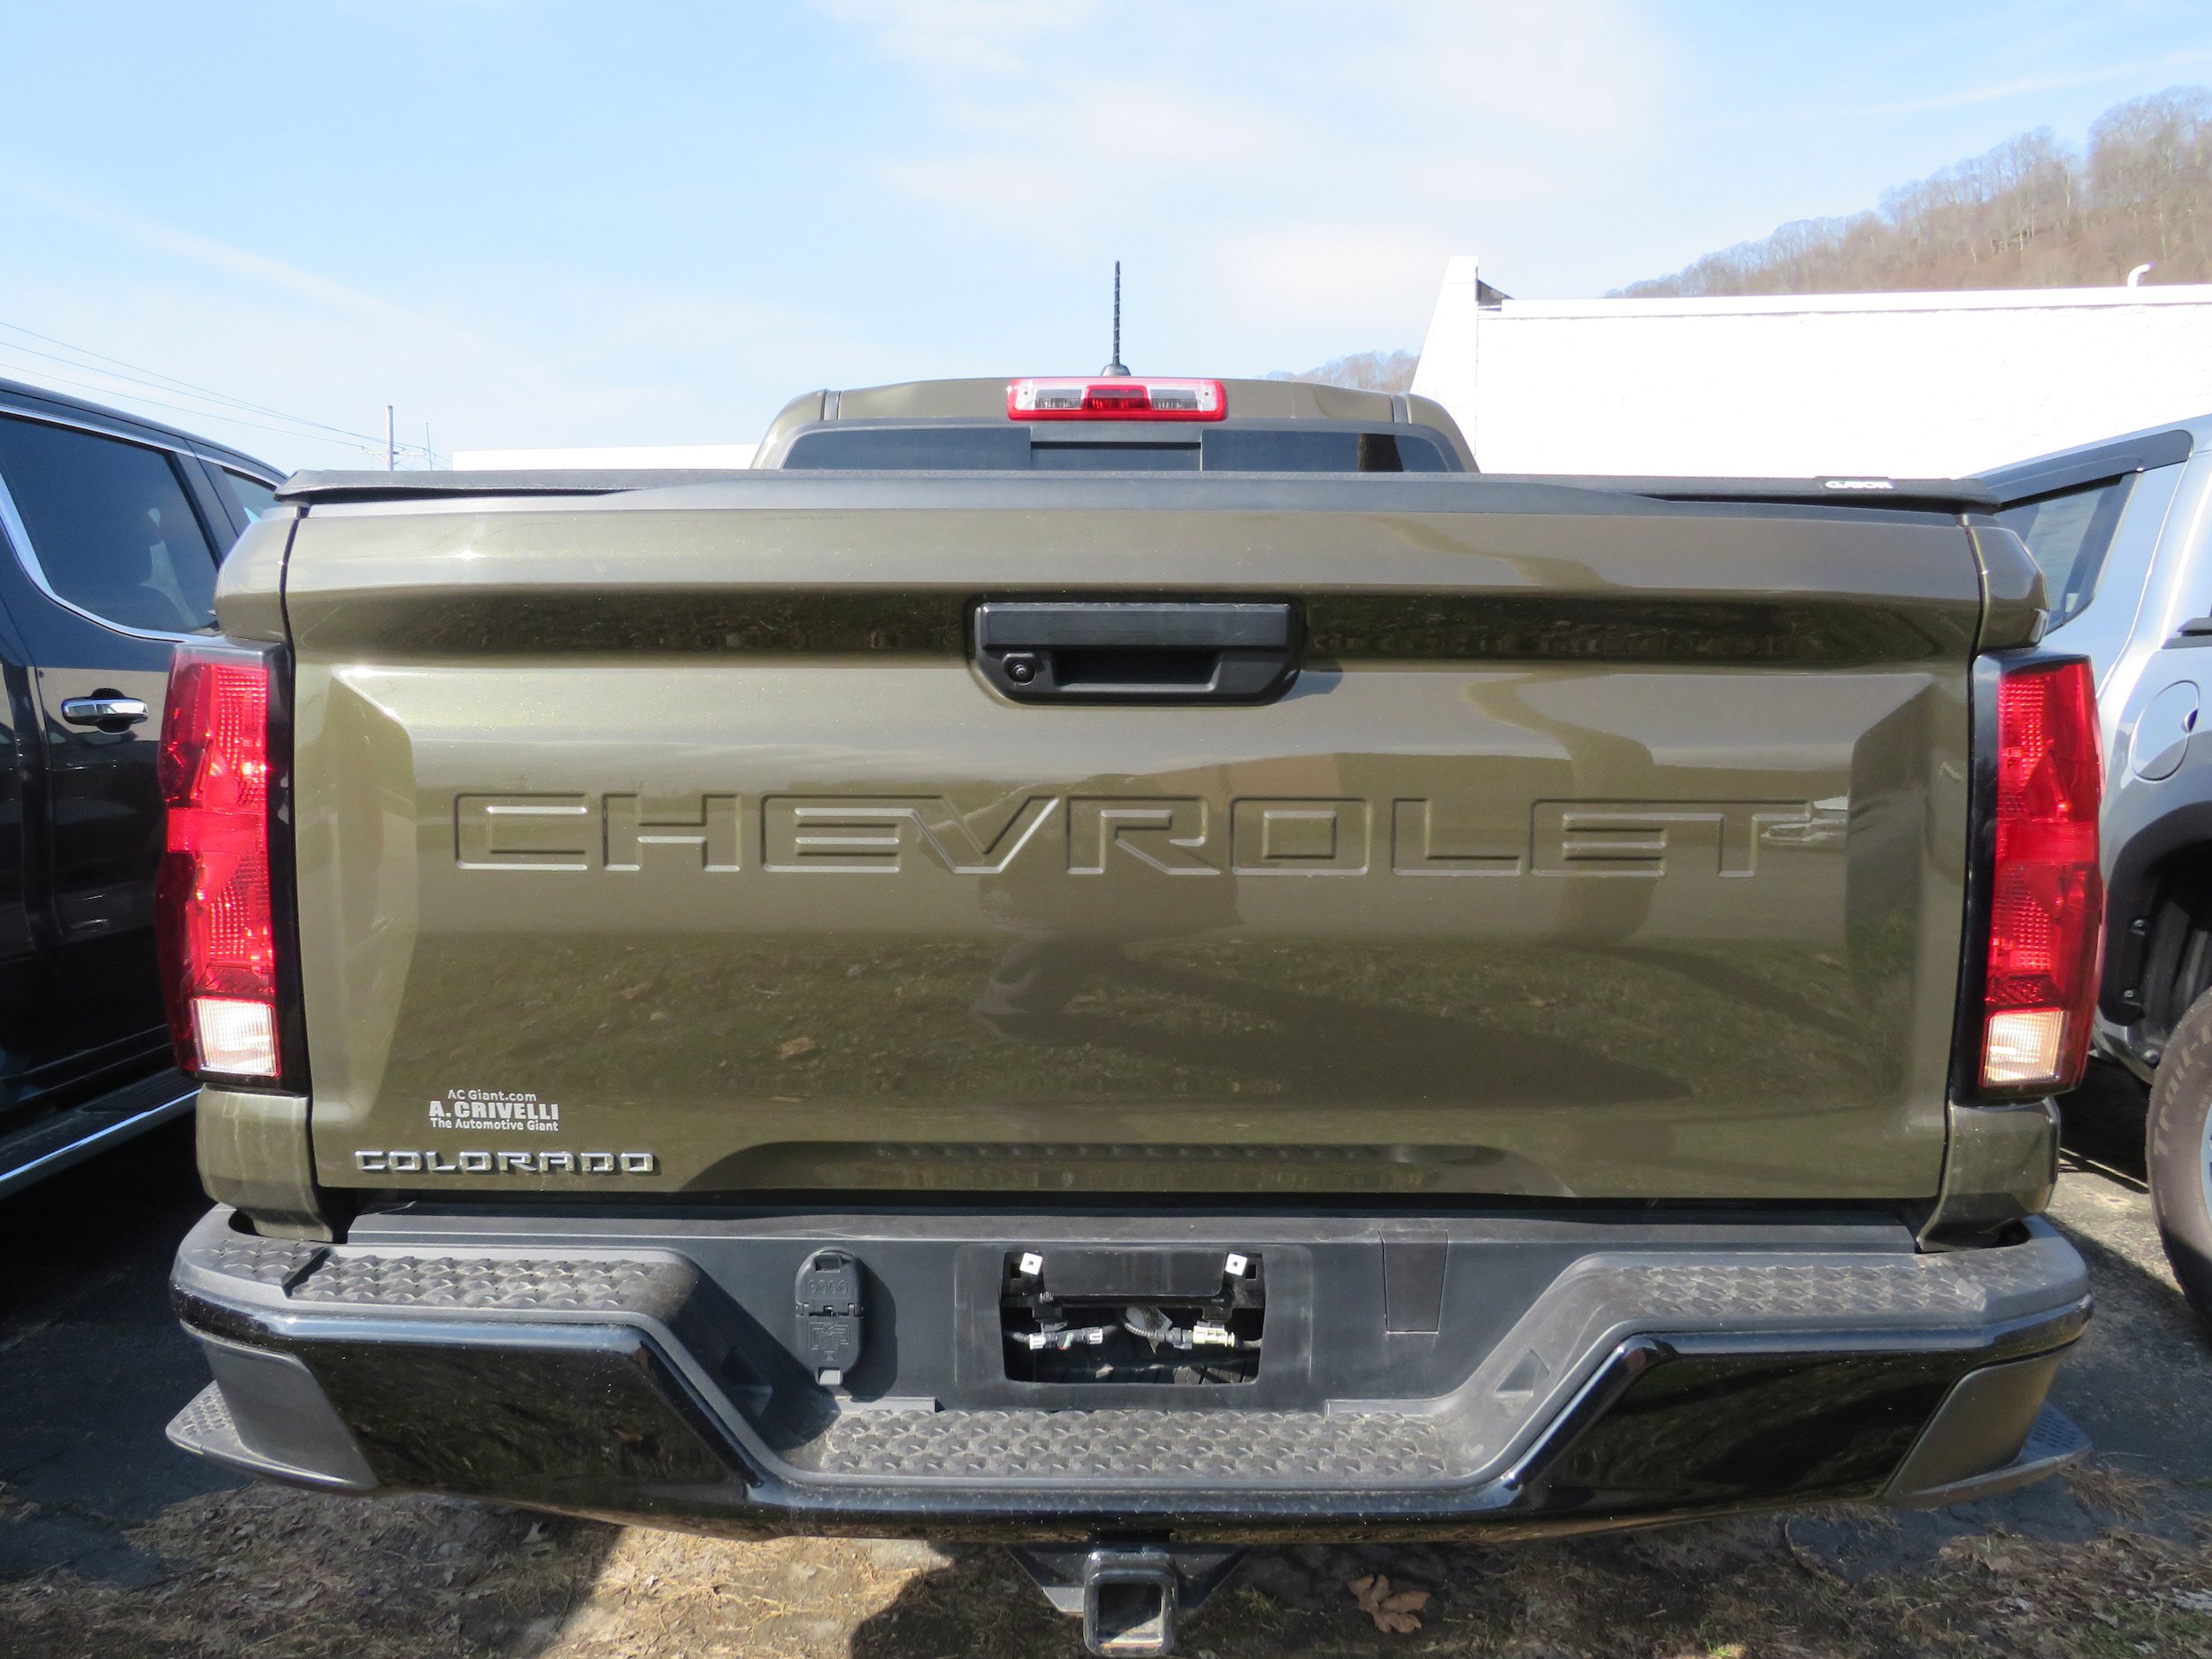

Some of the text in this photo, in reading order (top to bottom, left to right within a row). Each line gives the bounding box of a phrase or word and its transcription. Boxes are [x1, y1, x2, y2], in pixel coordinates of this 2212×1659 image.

[454, 793, 1812, 877] CHEVROLET
[428, 1101, 559, 1120] A. CRIVELLI
[430, 1118, 558, 1132] The Automotive Giant
[354, 1150, 653, 1172] COLORADO
